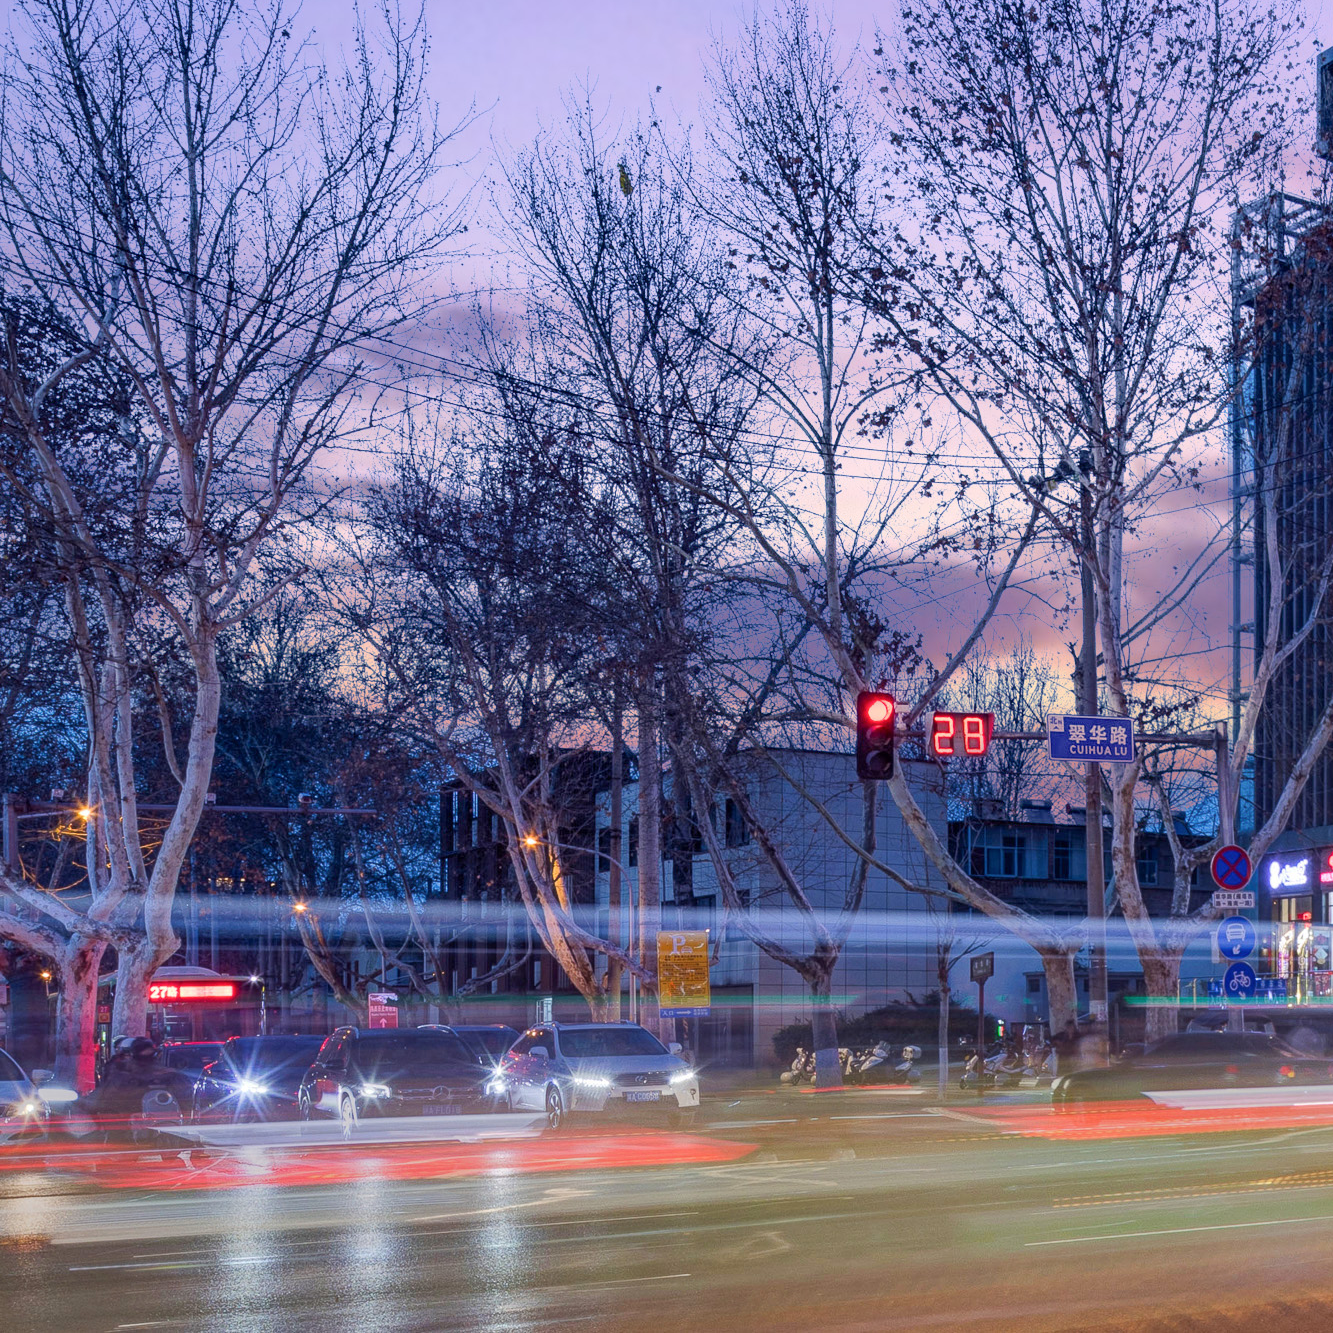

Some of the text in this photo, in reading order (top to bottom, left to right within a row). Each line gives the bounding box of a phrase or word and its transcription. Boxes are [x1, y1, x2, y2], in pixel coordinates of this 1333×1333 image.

[934, 716, 985, 754] 28
[1068, 724, 1128, 746] 翠华路
[1069, 744, 1128, 756] CUIHUA LU
